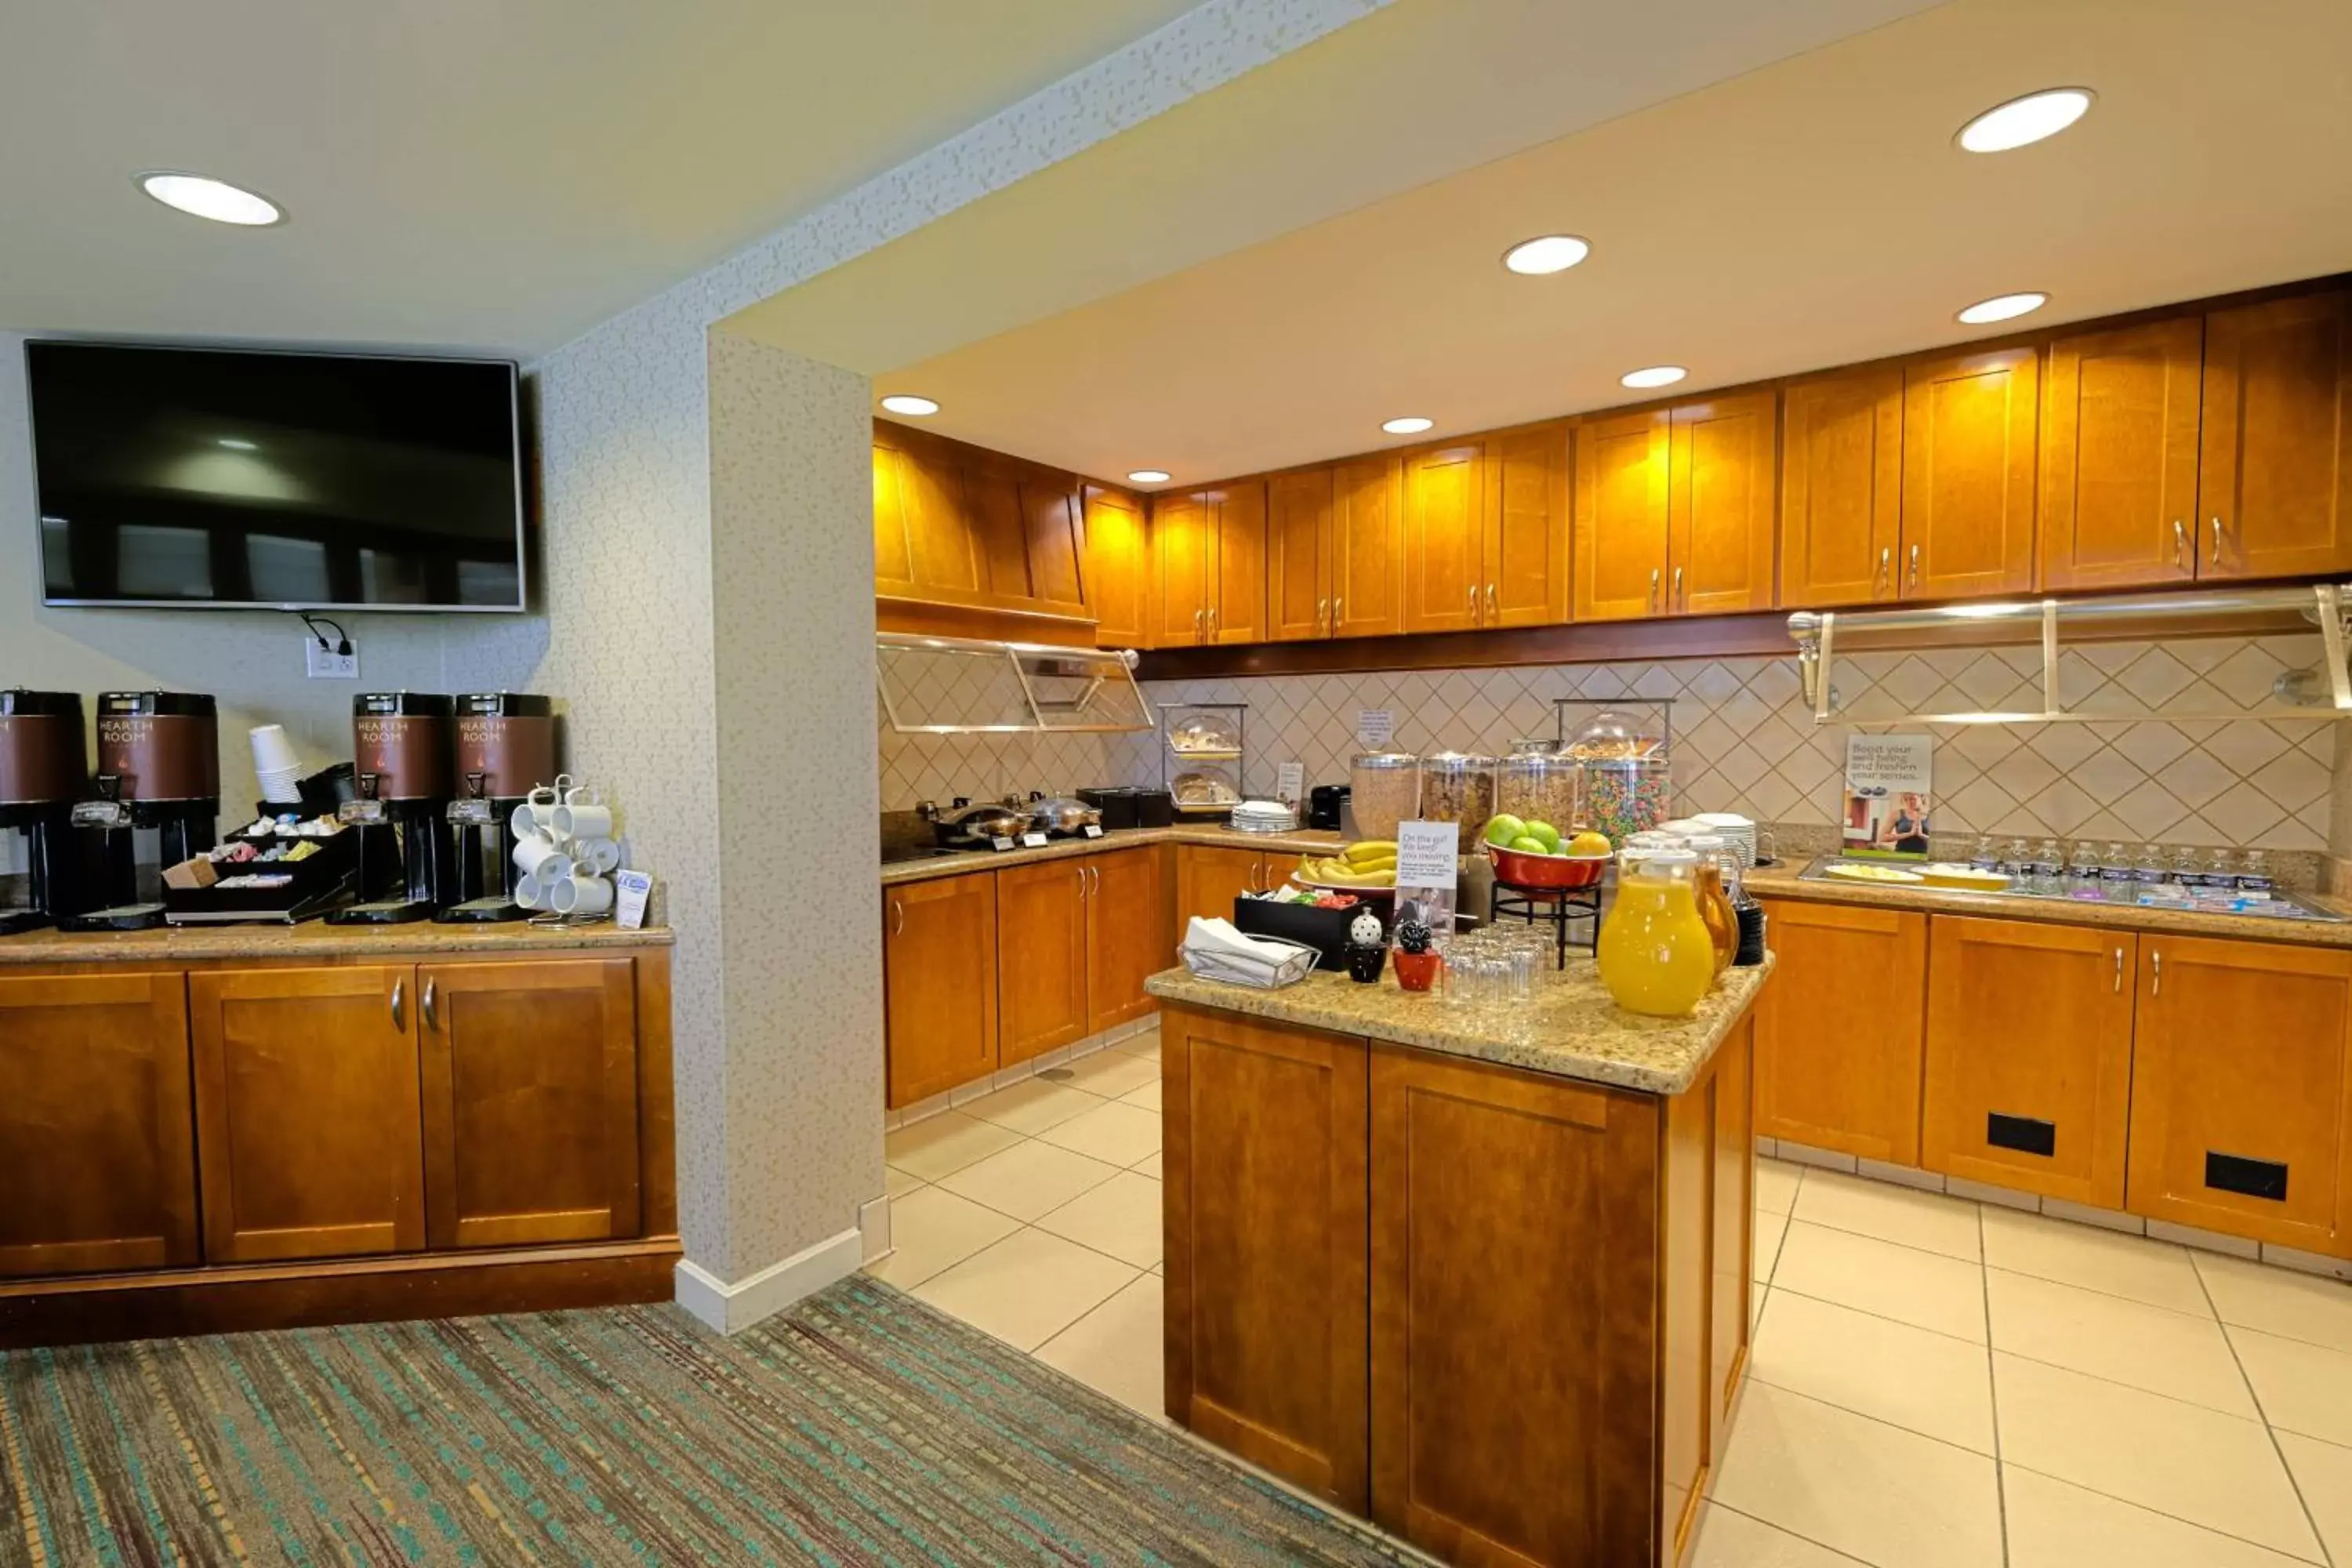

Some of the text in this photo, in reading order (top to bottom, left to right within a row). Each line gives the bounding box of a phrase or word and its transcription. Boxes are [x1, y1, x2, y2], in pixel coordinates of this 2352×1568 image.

[100, 720, 153, 731] HEARTH
[358, 720, 408, 731] HEARTH
[460, 720, 506, 731] HEARTH
[104, 731, 146, 742] ROOM
[363, 732, 402, 742] ROOM
[463, 732, 501, 742] ROOM
[1853, 743, 1911, 756] Boost your
[1851, 762, 1918, 771] and freshen
[1851, 772, 1875, 781] your
[1403, 833, 1415, 843] On
[1417, 834, 1431, 843] the
[1417, 842, 1438, 853] keep
[1402, 853, 1417, 862] you
